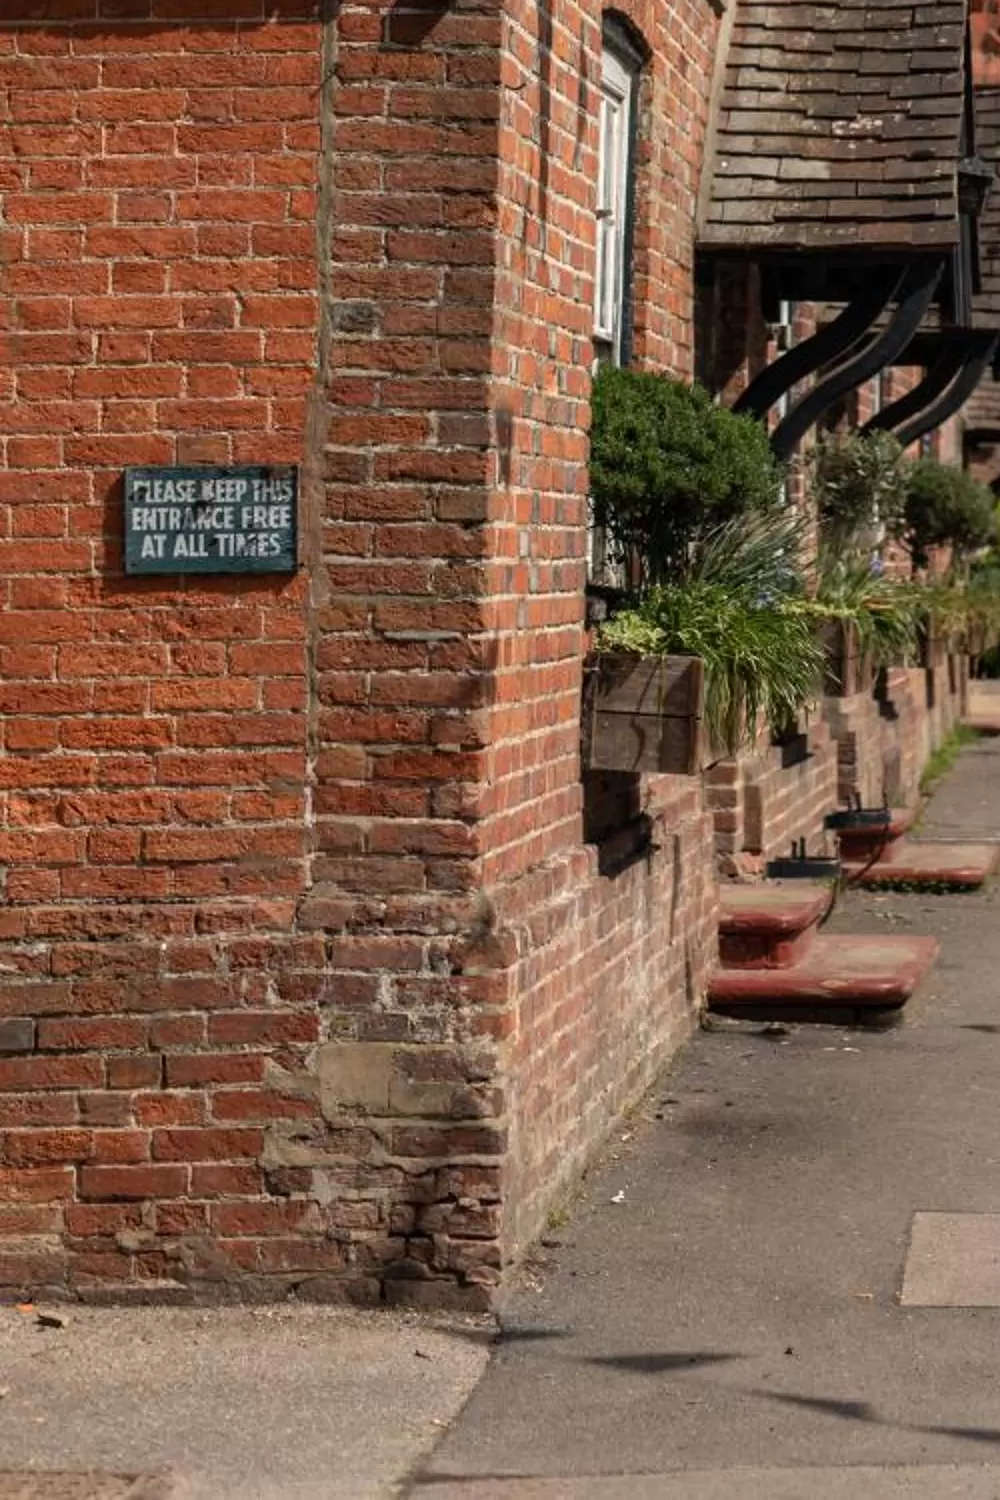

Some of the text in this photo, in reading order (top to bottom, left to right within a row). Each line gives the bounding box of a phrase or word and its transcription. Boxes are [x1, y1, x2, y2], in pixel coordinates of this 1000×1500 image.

[132, 479, 293, 503] PLEASE KEEP THIS
[131, 505, 292, 532] ENTRANCE FREE
[140, 532, 282, 559] AT ALL TIMES
